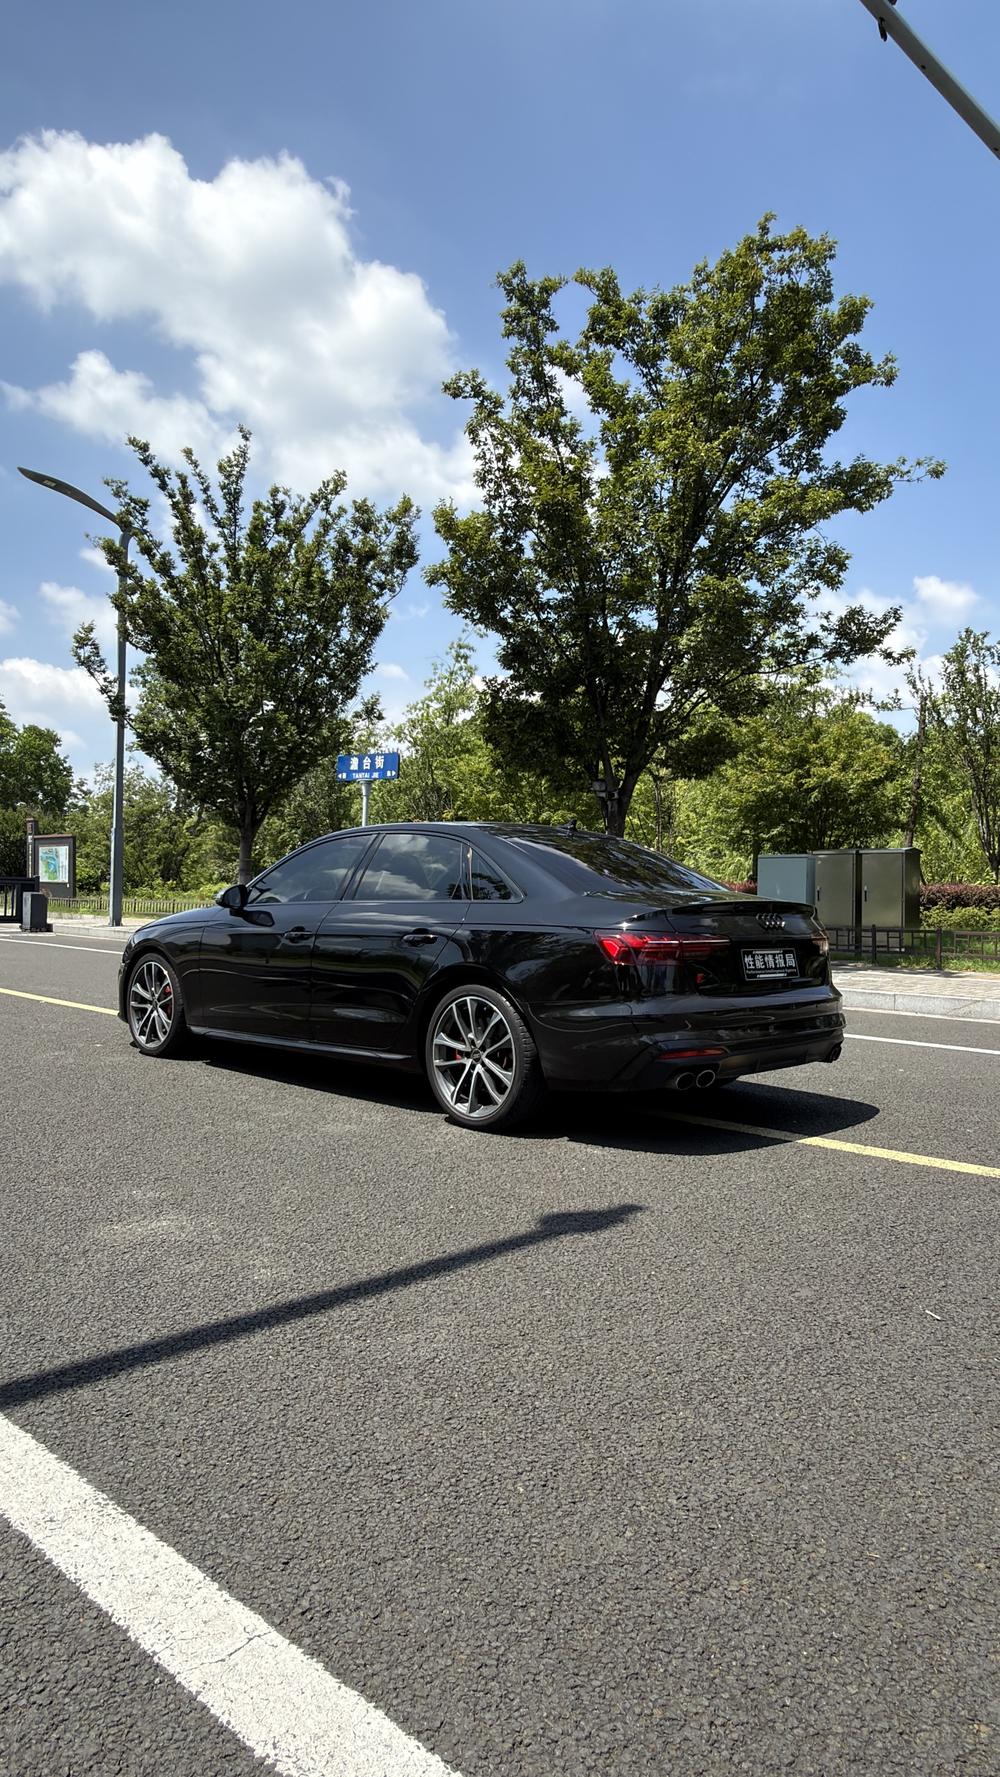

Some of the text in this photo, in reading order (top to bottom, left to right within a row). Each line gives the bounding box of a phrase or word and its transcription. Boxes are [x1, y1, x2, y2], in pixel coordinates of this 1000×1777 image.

[744, 953, 796, 969] 性能情报局
